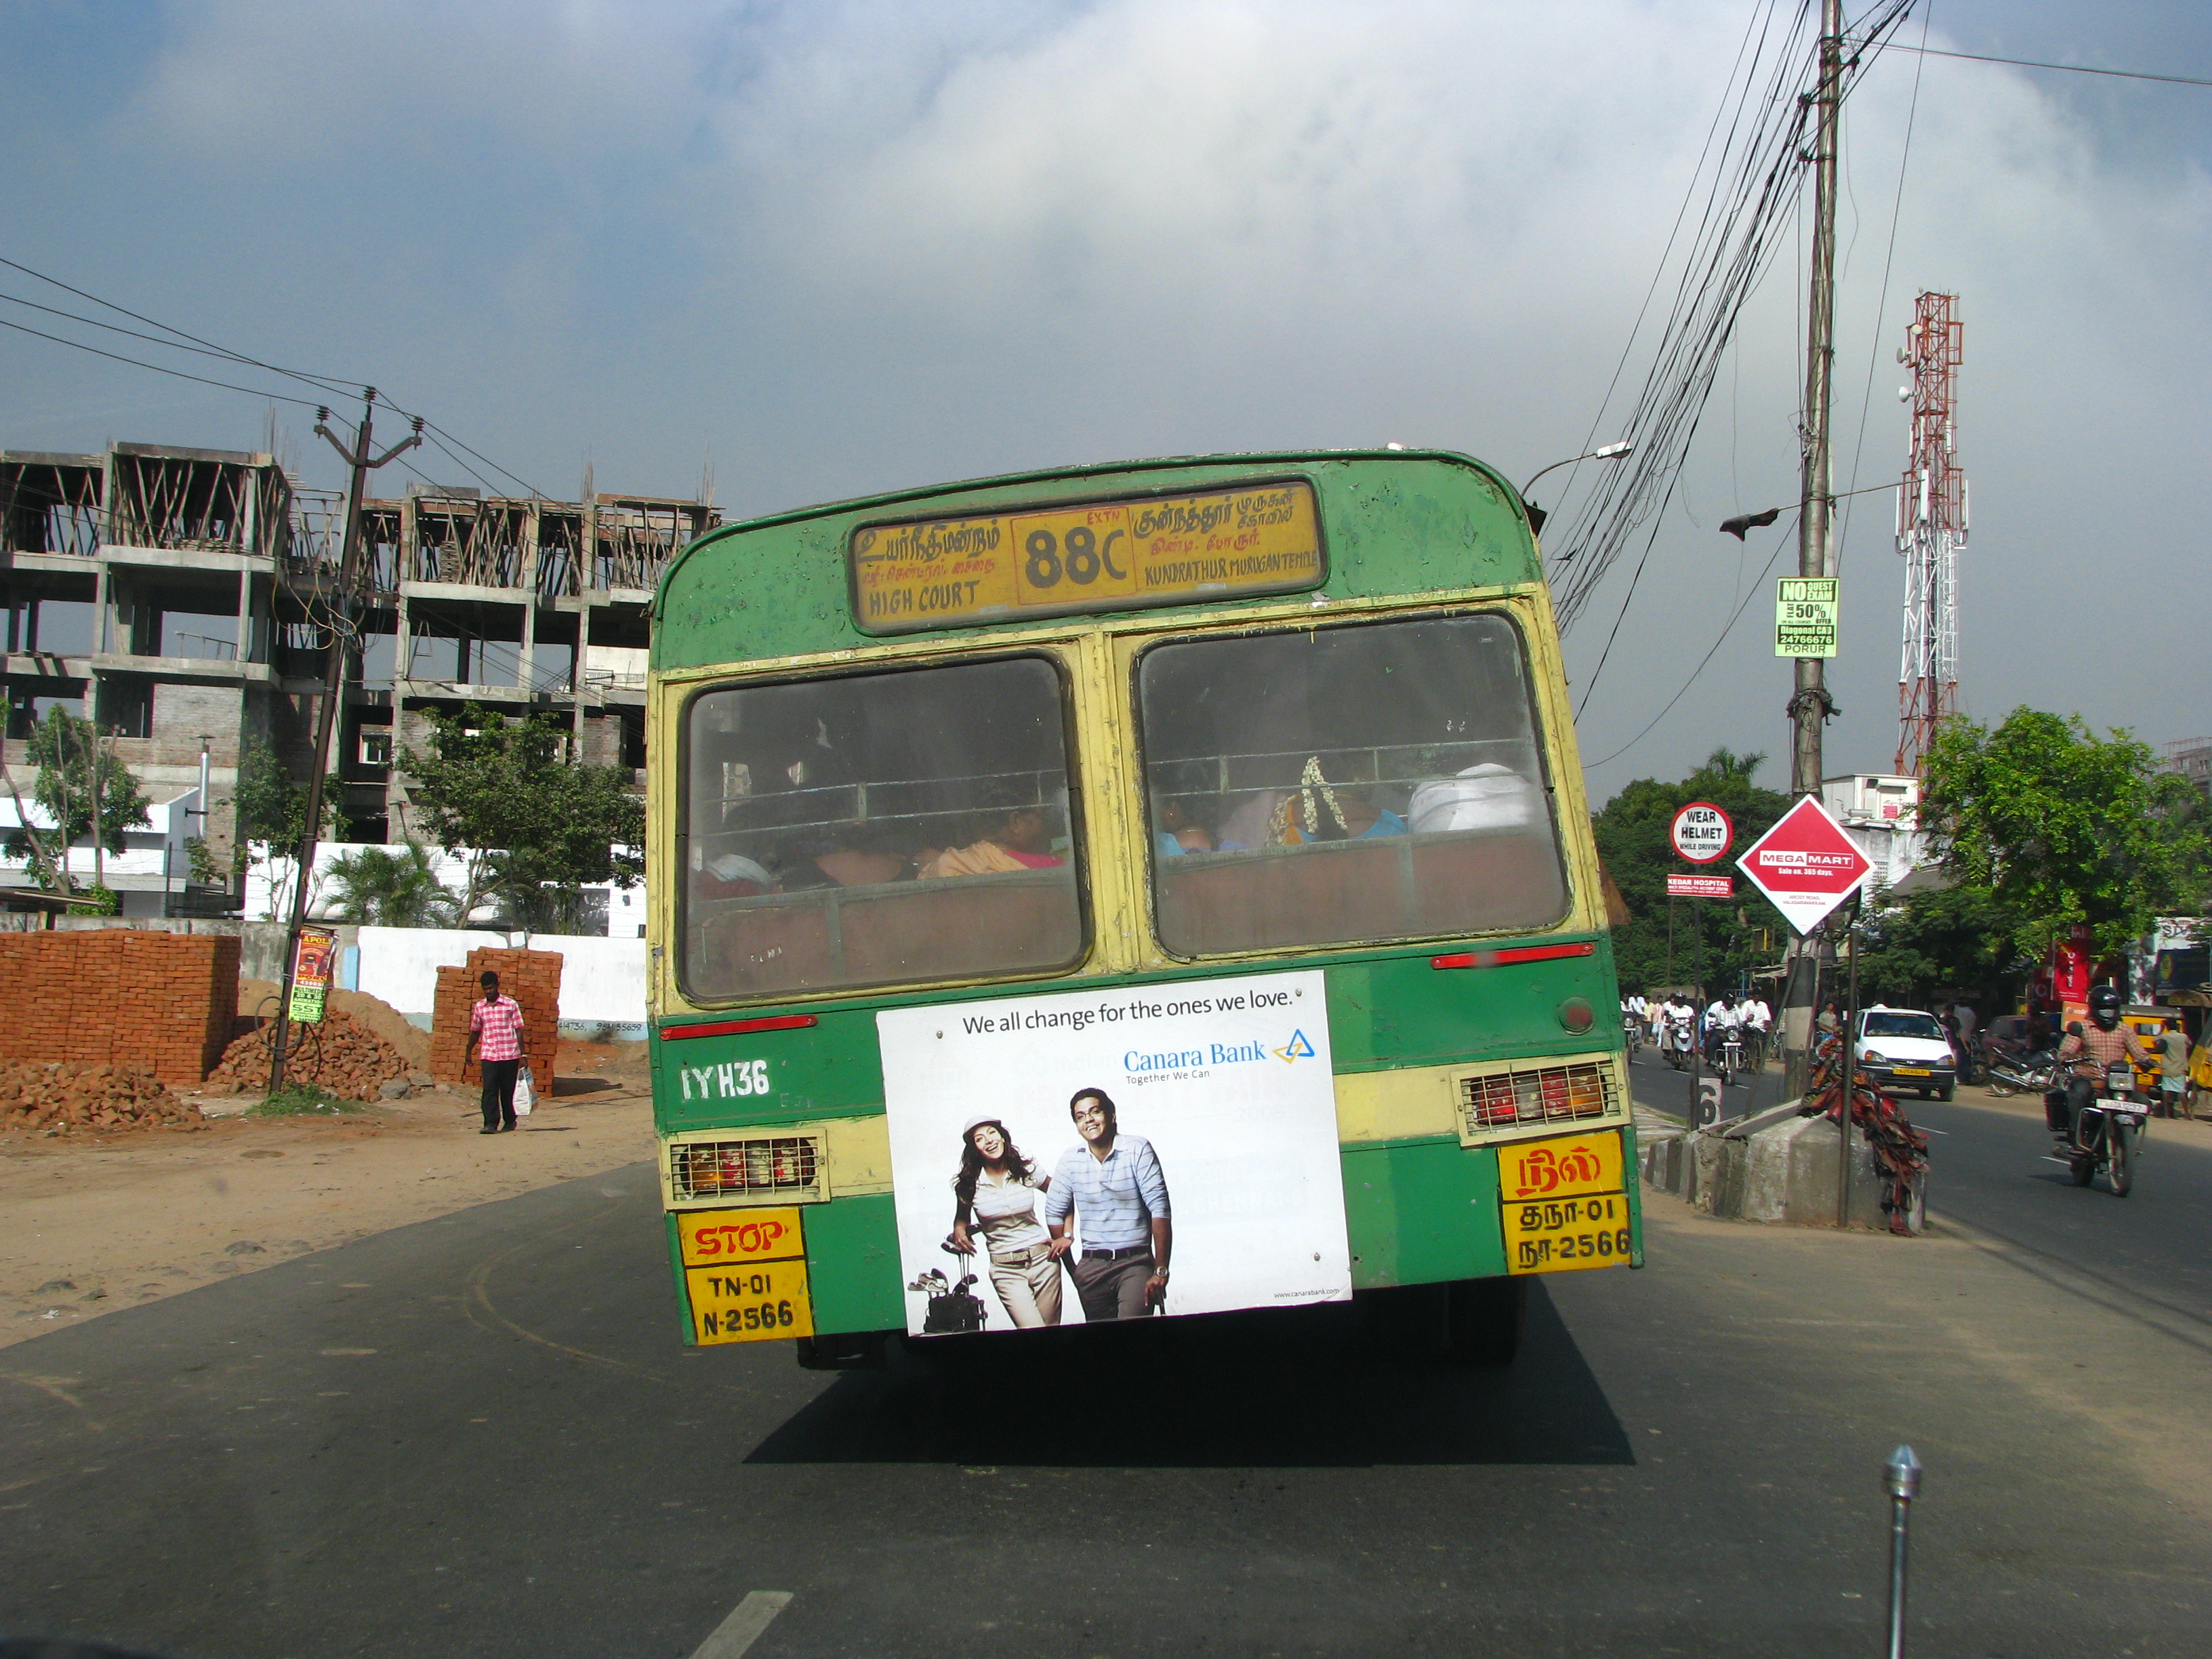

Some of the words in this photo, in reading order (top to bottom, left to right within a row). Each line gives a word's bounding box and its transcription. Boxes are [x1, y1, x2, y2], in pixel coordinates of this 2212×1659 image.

[1087, 510, 1120, 525] EXTN
[1025, 526, 1127, 588] 88C
[1145, 557, 1228, 586] KUNDRATHUR
[1230, 552, 1280, 576] MURUGAN
[1280, 550, 1318, 570] TEMPLE
[869, 587, 913, 617] HIGH
[918, 579, 980, 611] COURT
[1782, 581, 1807, 601] NO
[1807, 590, 1832, 601] EXAM
[1796, 604, 1826, 619] 50%
[1780, 626, 1815, 636] Diagonal
[1784, 644, 1826, 653] PORUR
[1686, 811, 1716, 823] WEAR
[1681, 827, 1723, 840] HELMET
[1763, 855, 1805, 863] MEGA
[1808, 855, 1851, 865] MART
[1694, 879, 1729, 887] HOSPITAL
[292, 1004, 323, 1014] SST
[962, 1016, 994, 1034] We
[1000, 1011, 1021, 1031] all
[1025, 1010, 1095, 1031] change
[1099, 1003, 1126, 1022] for
[1129, 1000, 1162, 1019] the
[1167, 999, 1212, 1016] ones
[1215, 996, 1245, 1011] we
[1250, 990, 1293, 1008] love.
[1124, 1049, 1204, 1072] Canara
[1210, 1040, 1267, 1065] Bank
[1126, 1072, 1170, 1086] Together
[1173, 1071, 1189, 1081] We
[1191, 1069, 1210, 1079] Can
[1515, 1145, 1601, 1198] நில்
[695, 1221, 783, 1255] STOP
[708, 1274, 771, 1297] TN-01
[1273, 1288, 1340, 1298] www.canarabank.com
[703, 1300, 794, 1337] N-2566
